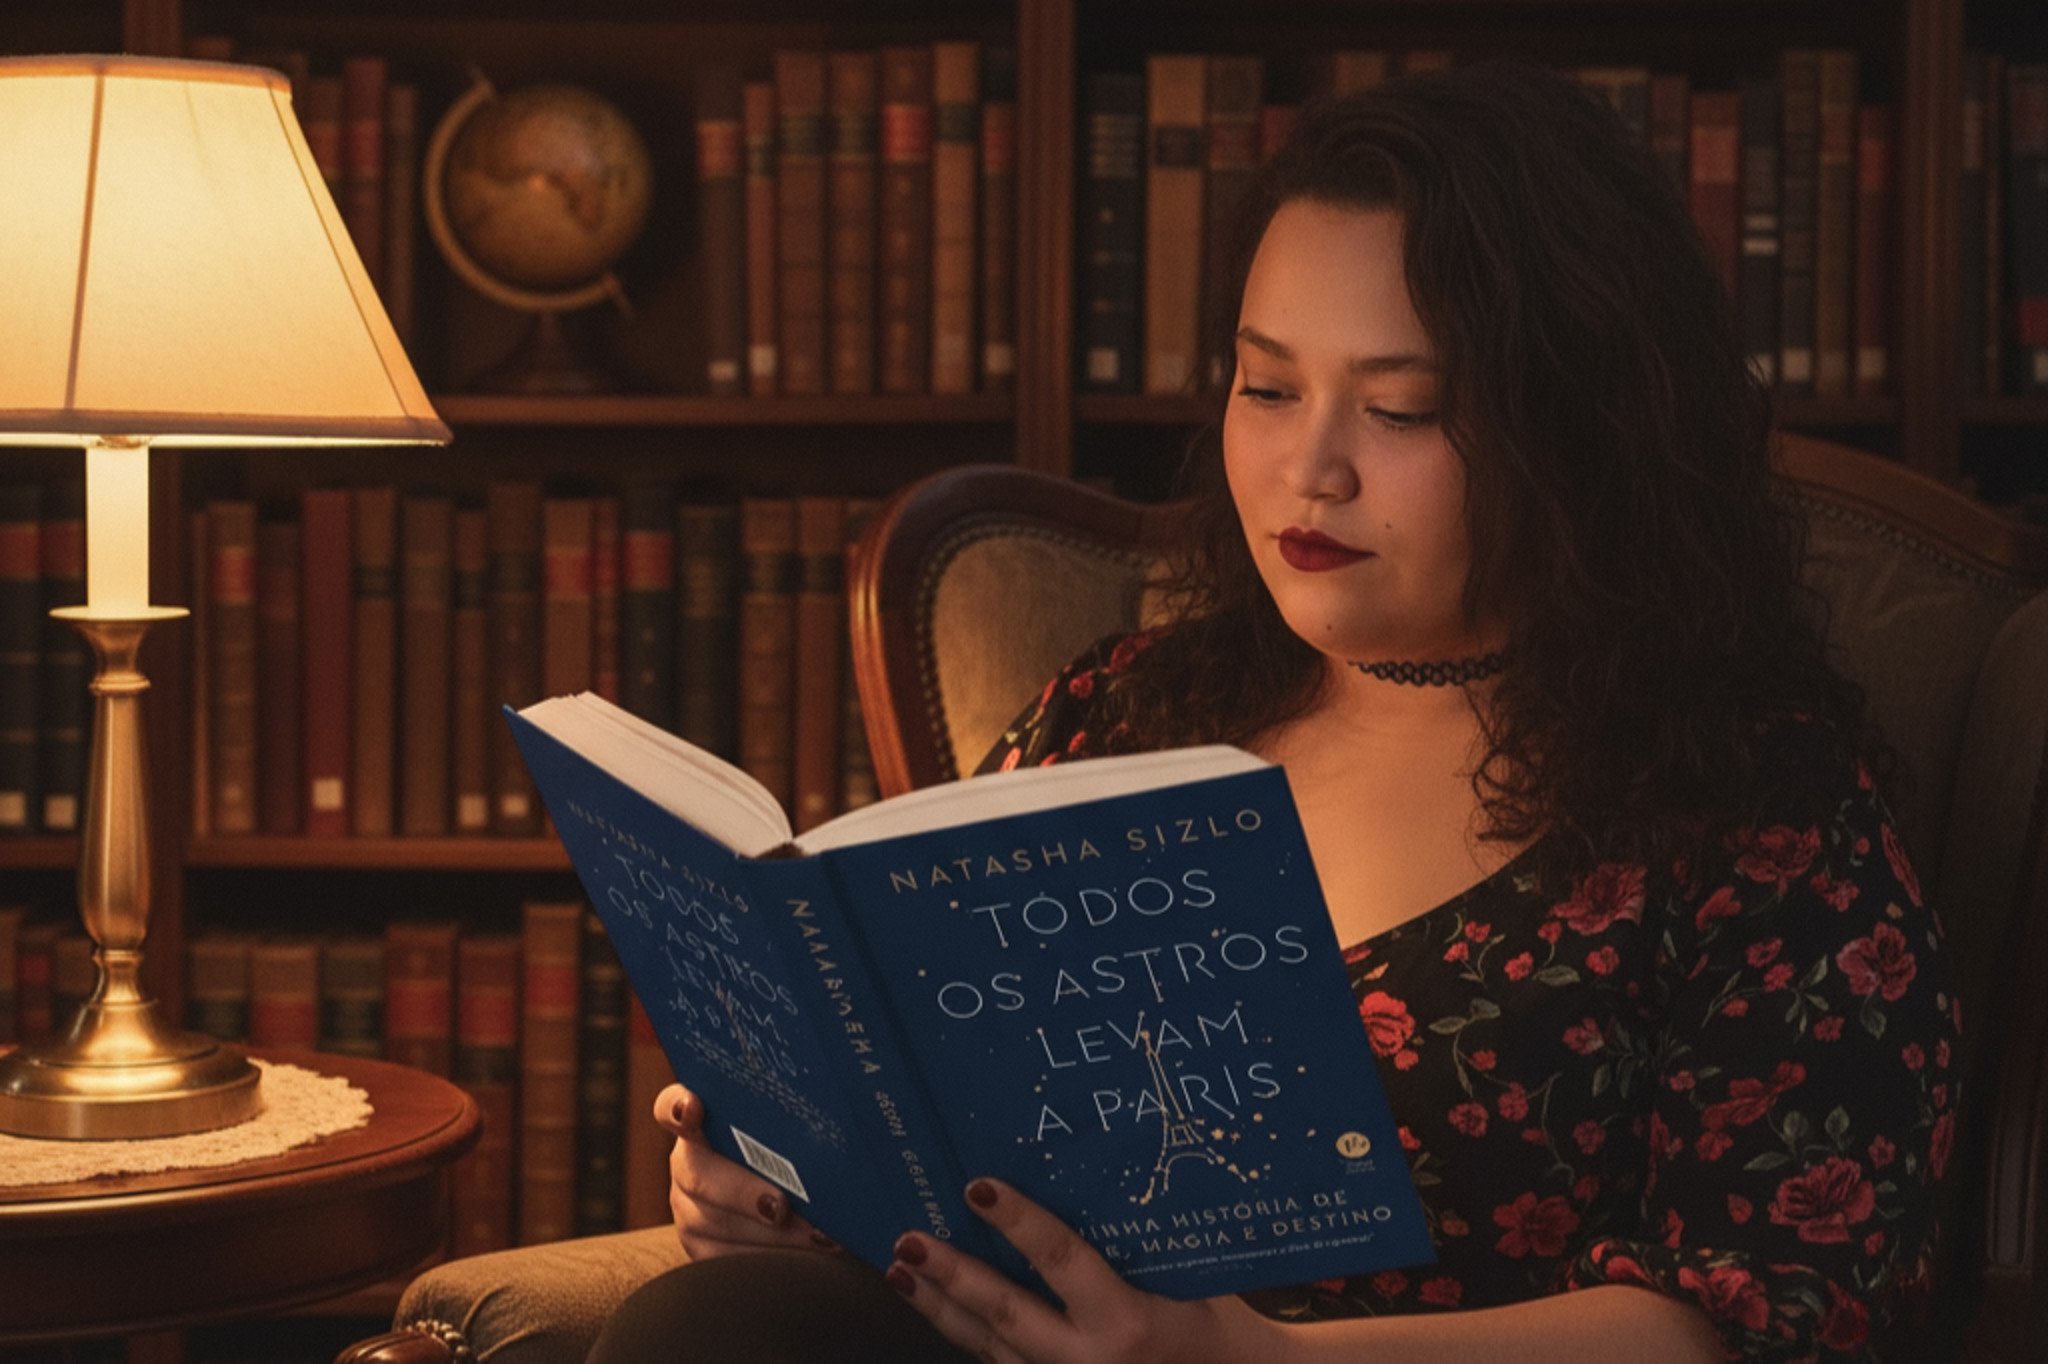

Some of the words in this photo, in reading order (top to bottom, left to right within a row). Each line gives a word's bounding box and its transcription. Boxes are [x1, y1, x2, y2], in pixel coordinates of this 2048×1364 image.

[889, 838, 1101, 894] NATASHA
[1126, 809, 1262, 851] SIZLO
[971, 869, 1215, 947] TODOS
[937, 973, 1025, 1018] OS
[1053, 926, 1308, 1003] ASTROS
[1037, 1007, 1249, 1067] LEVAM
[1036, 1105, 1072, 1140] A
[1093, 1062, 1281, 1130] PARIS
[1079, 1218, 1161, 1240] INHA
[1313, 1190, 1347, 1208] DE
[1141, 1230, 1231, 1254] MAGIA
[1243, 1226, 1257, 1242] E
[1272, 1206, 1392, 1236] DESTINO
